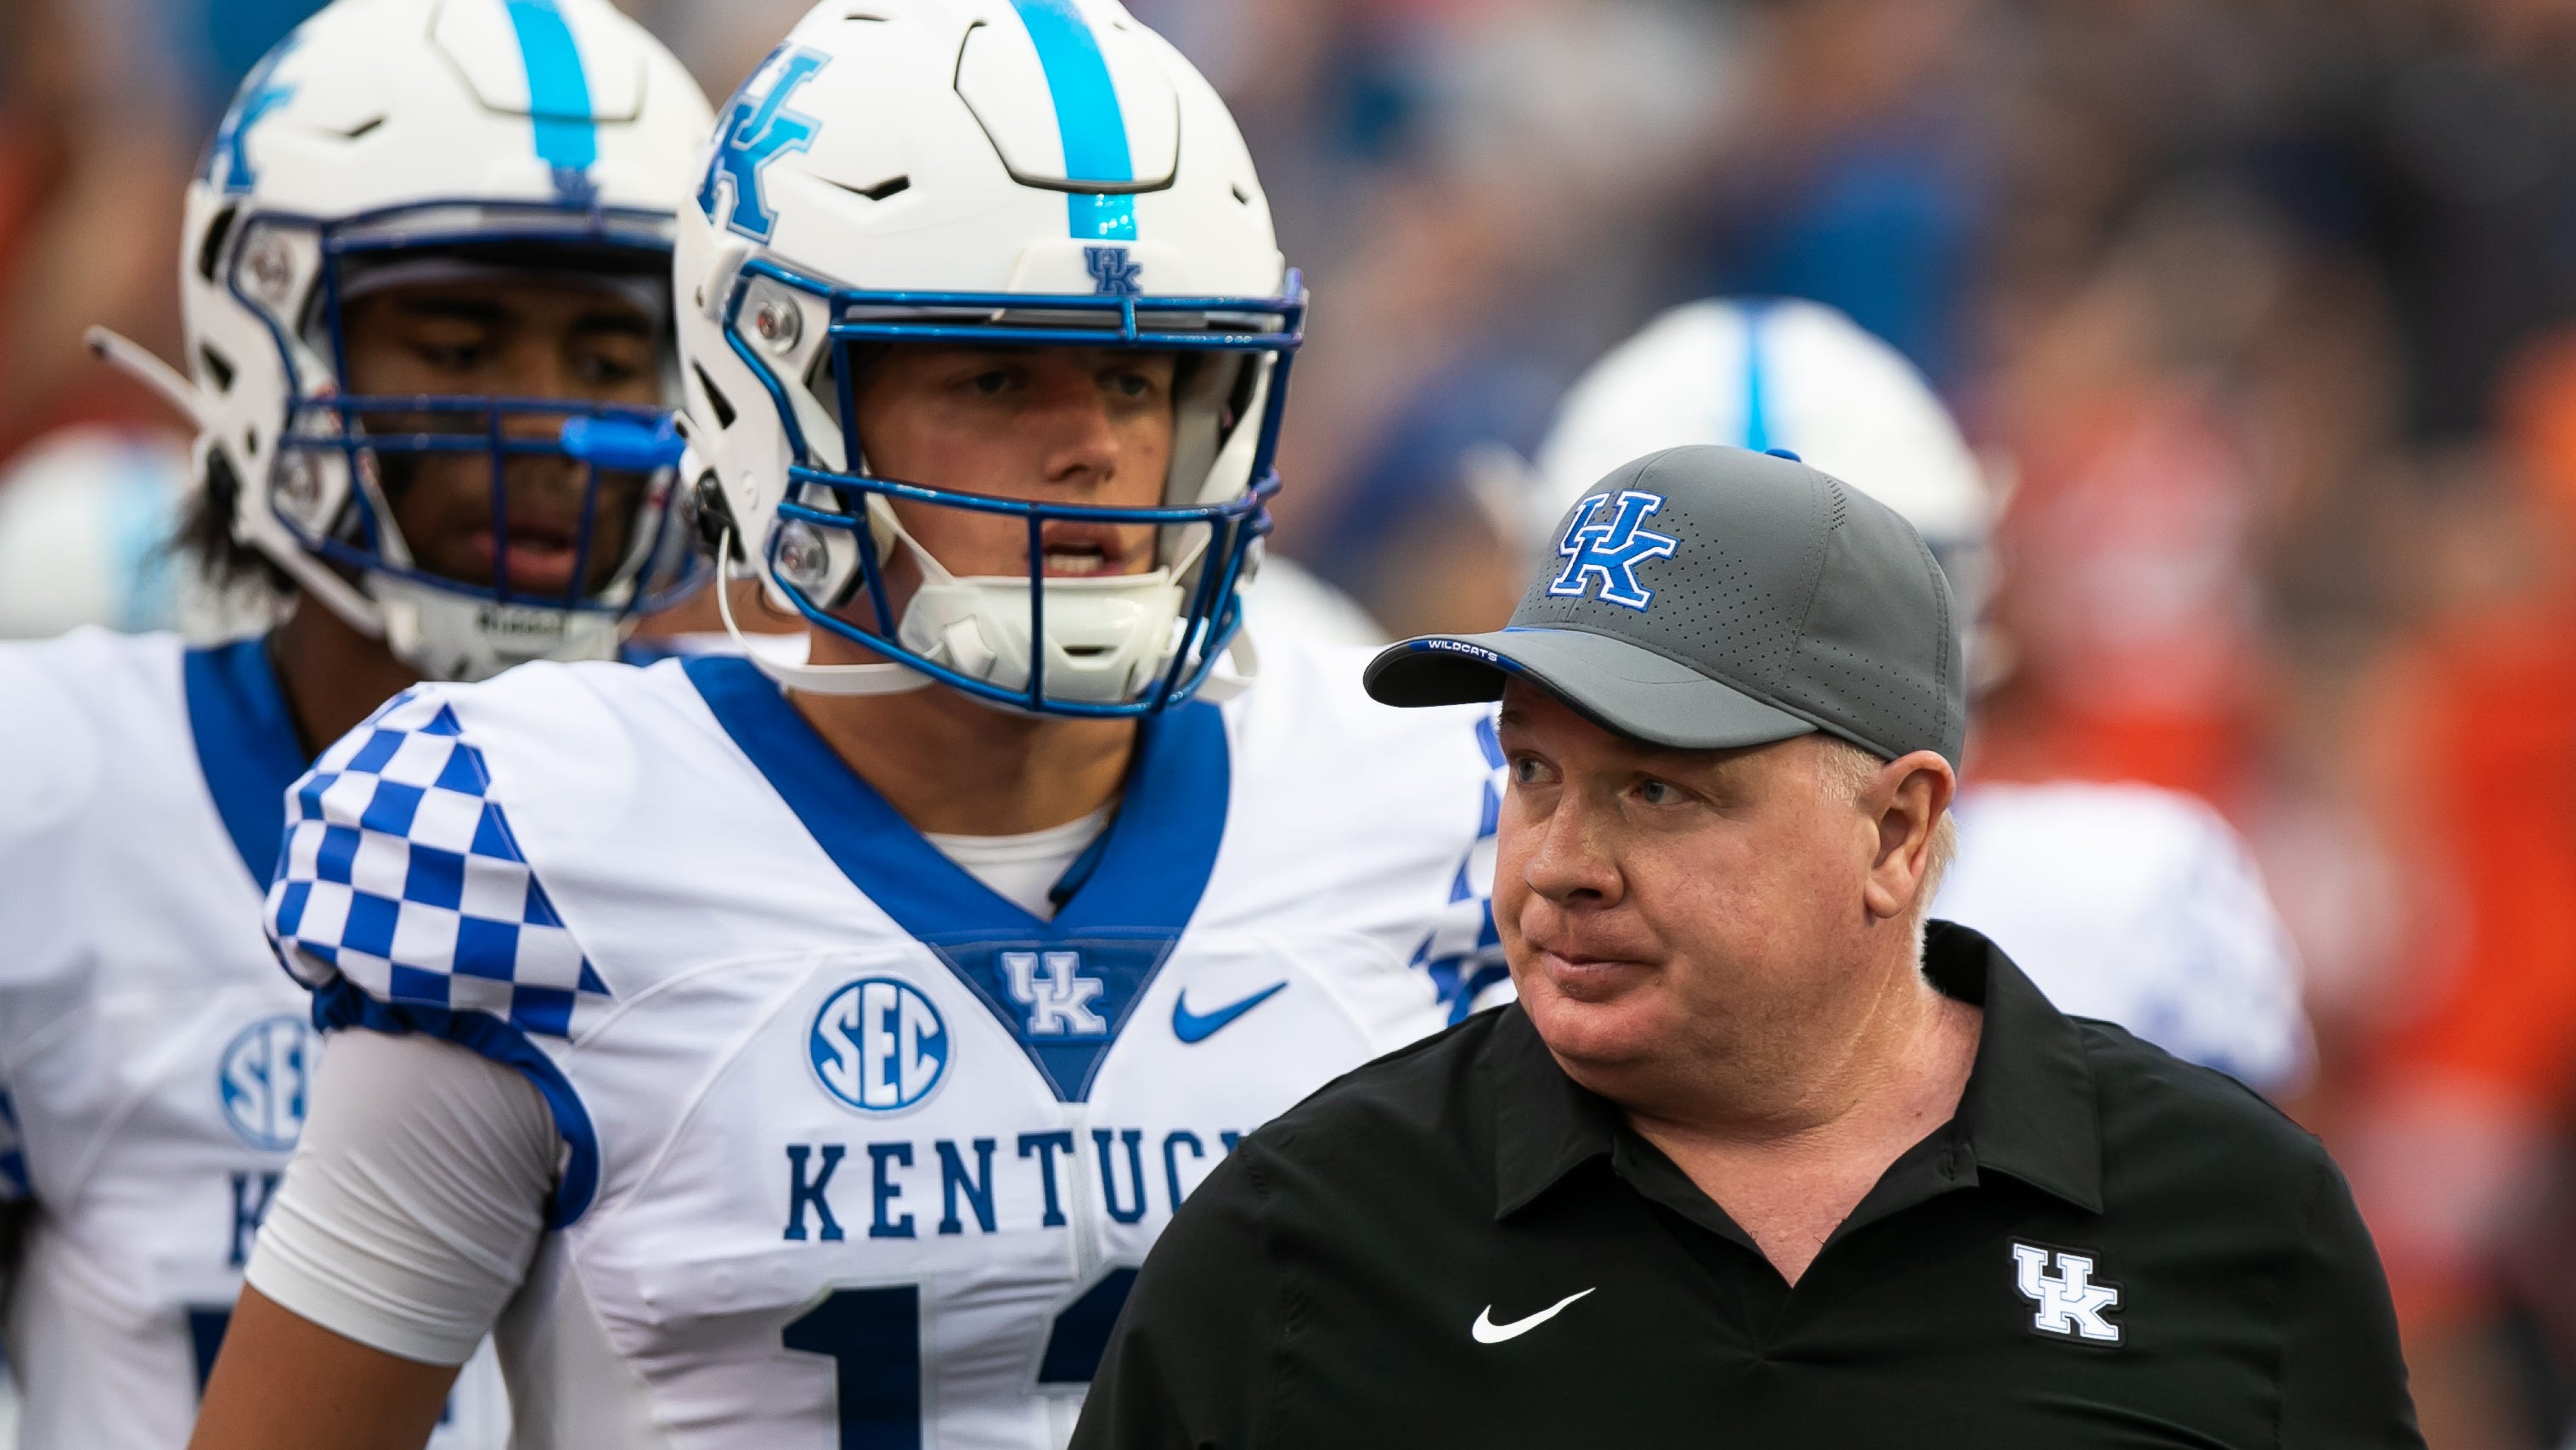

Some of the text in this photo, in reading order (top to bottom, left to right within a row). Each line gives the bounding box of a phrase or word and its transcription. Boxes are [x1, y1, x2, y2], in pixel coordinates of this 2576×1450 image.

[1084, 246, 1143, 296] UK
[1546, 490, 1680, 612] UK
[1428, 640, 1498, 662] WILDCATS
[817, 982, 939, 1104] SEC
[1003, 952, 1108, 1035] UK
[228, 1025, 322, 1140] SE
[783, 1128, 1237, 1241] KENTUC
[2012, 1243, 2119, 1341] UK
